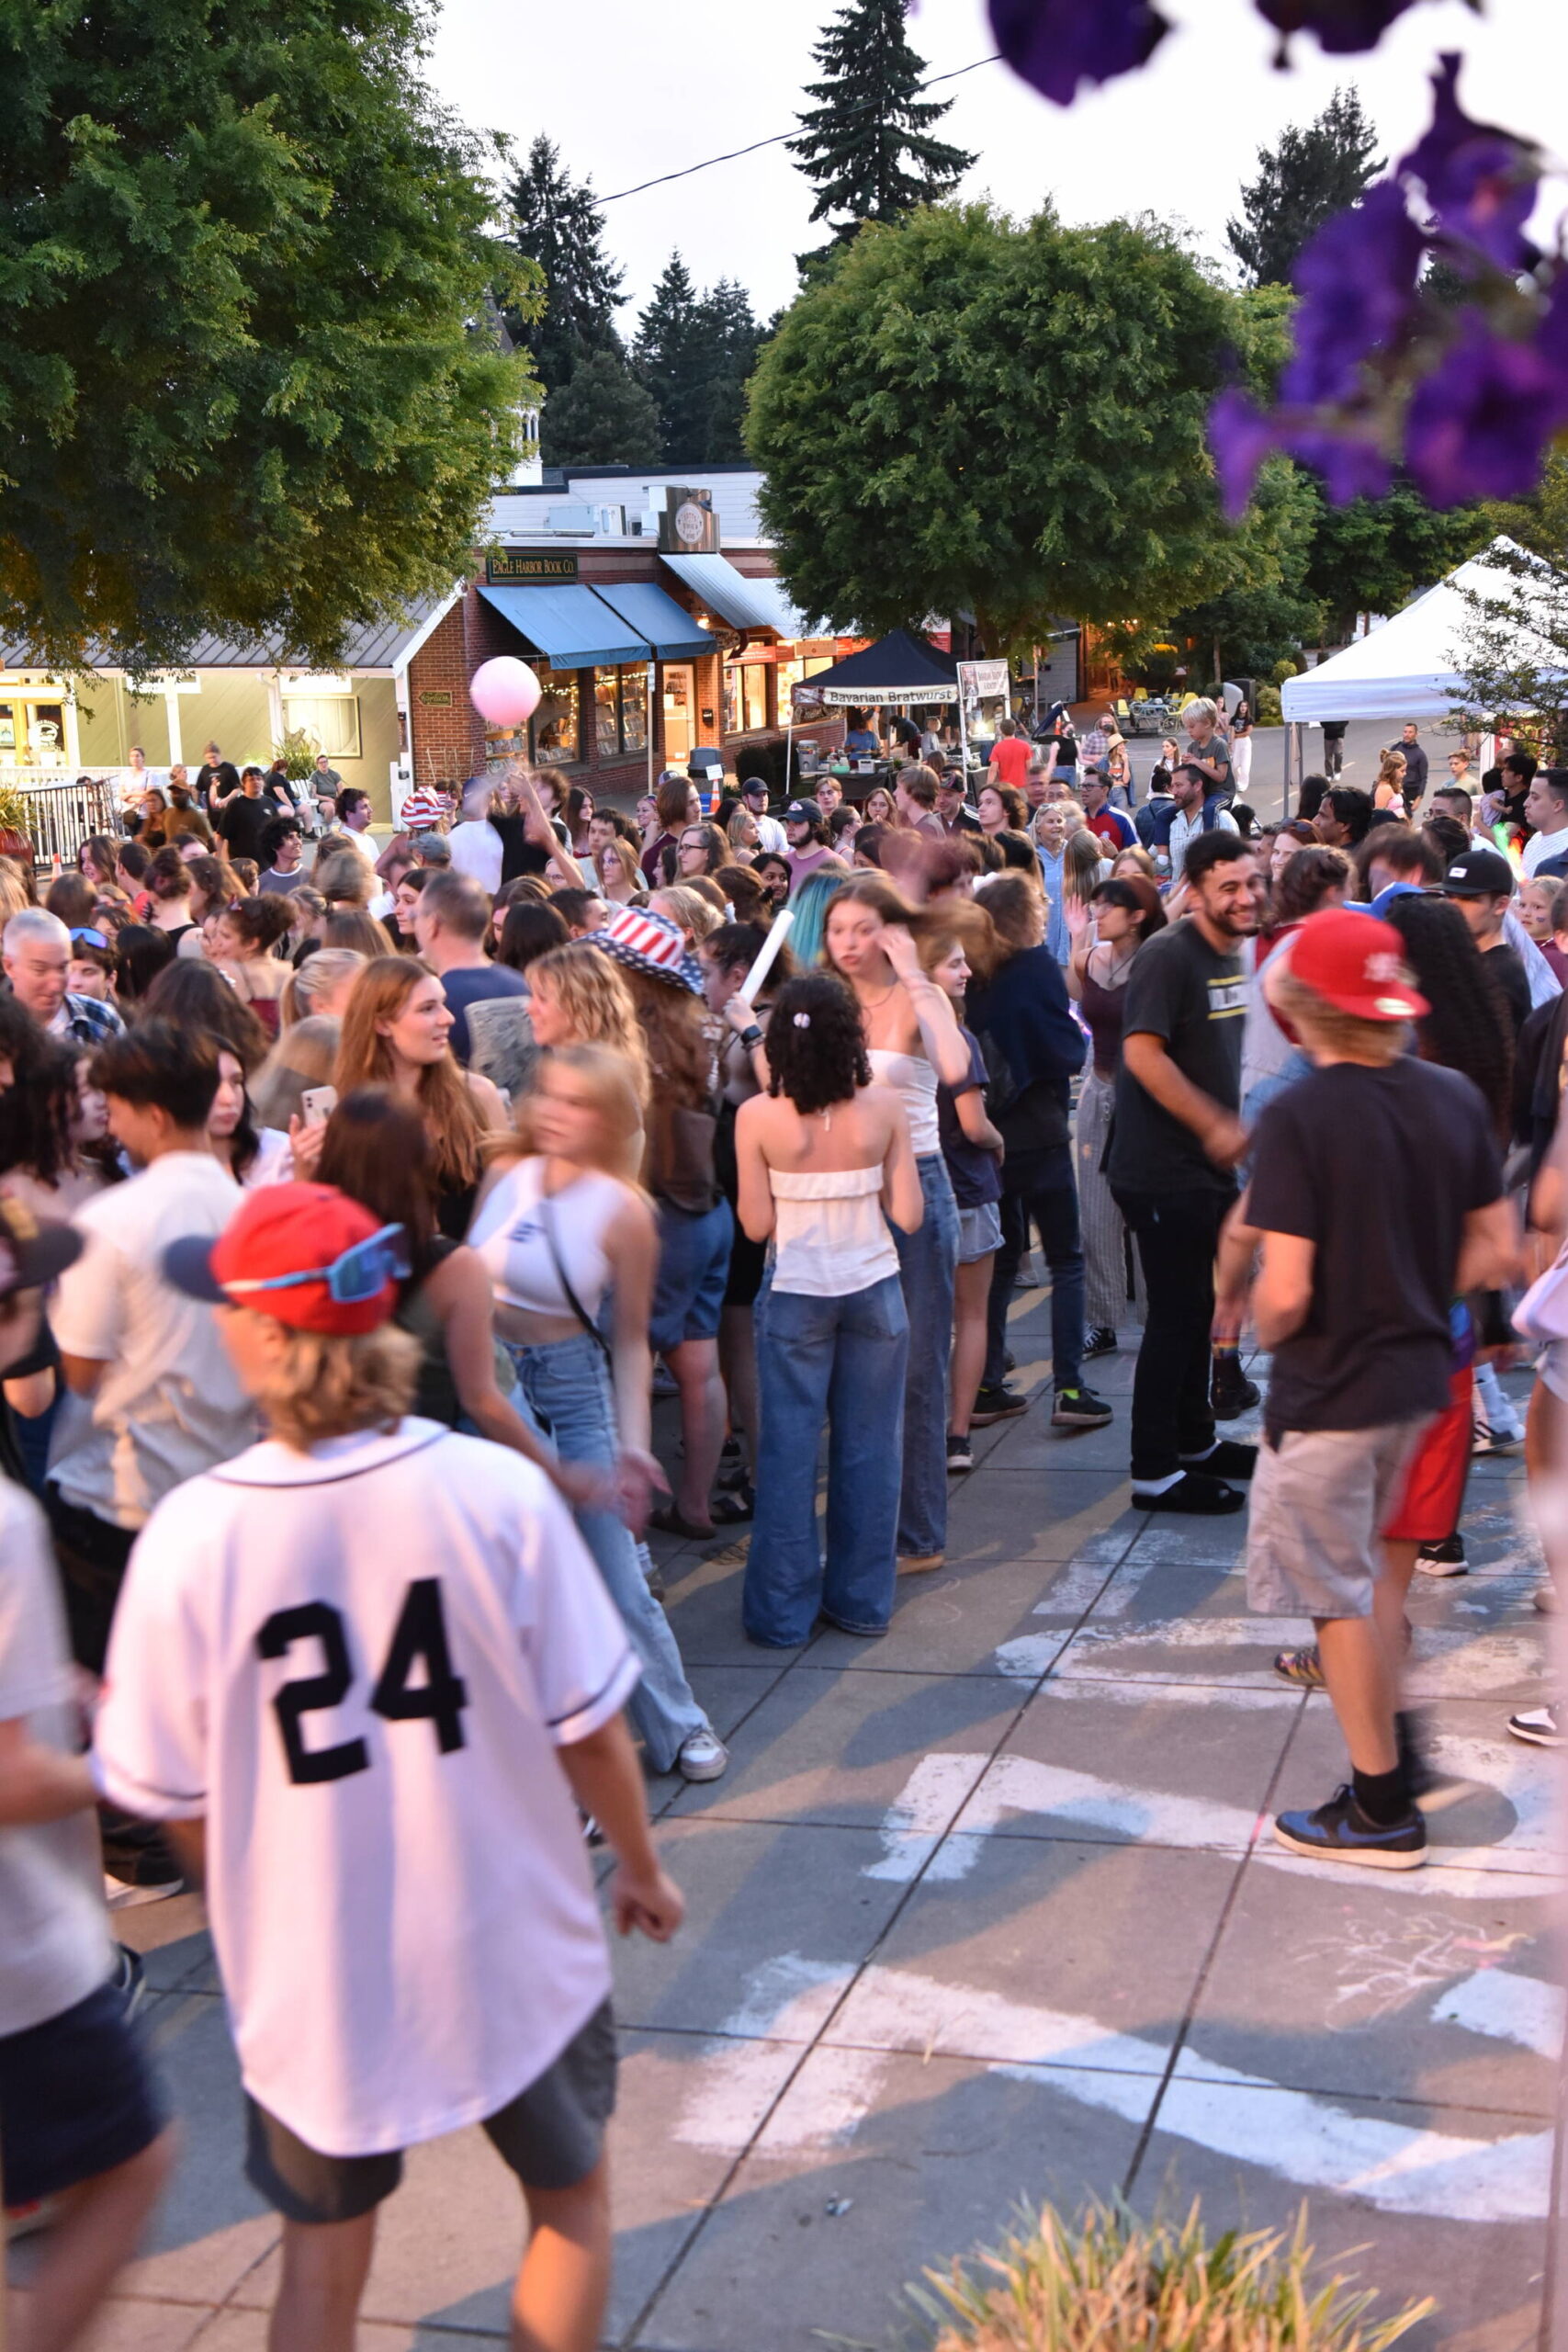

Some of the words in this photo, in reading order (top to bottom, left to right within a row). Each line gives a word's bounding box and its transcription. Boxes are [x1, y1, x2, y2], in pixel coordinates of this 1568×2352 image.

[515, 559, 543, 574] HARBOR
[544, 559, 562, 574] BOOK
[829, 692, 884, 703] Bavarian
[888, 689, 953, 703] Bratwurst
[254, 1577, 469, 1786] 24
